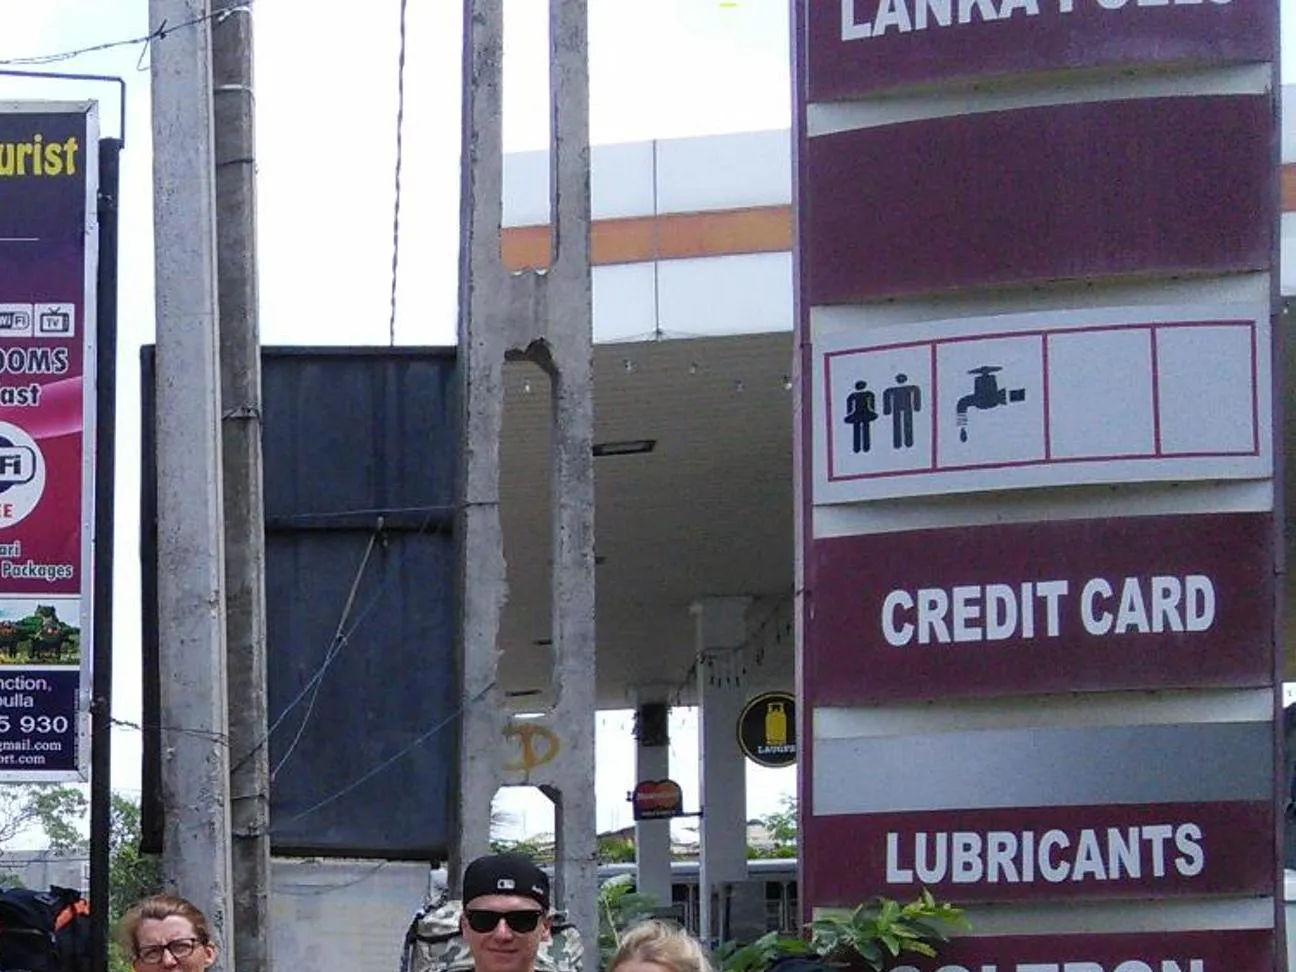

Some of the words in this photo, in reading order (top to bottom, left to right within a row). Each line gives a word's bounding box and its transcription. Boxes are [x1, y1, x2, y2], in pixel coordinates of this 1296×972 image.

[46, 317, 60, 328] TV
[1, 560, 73, 582] Packages
[881, 580, 1069, 647] CREDIT
[1080, 574, 1216, 637] CARD
[20, 716, 68, 733] 930
[885, 823, 1205, 884] LUBRICANTS
